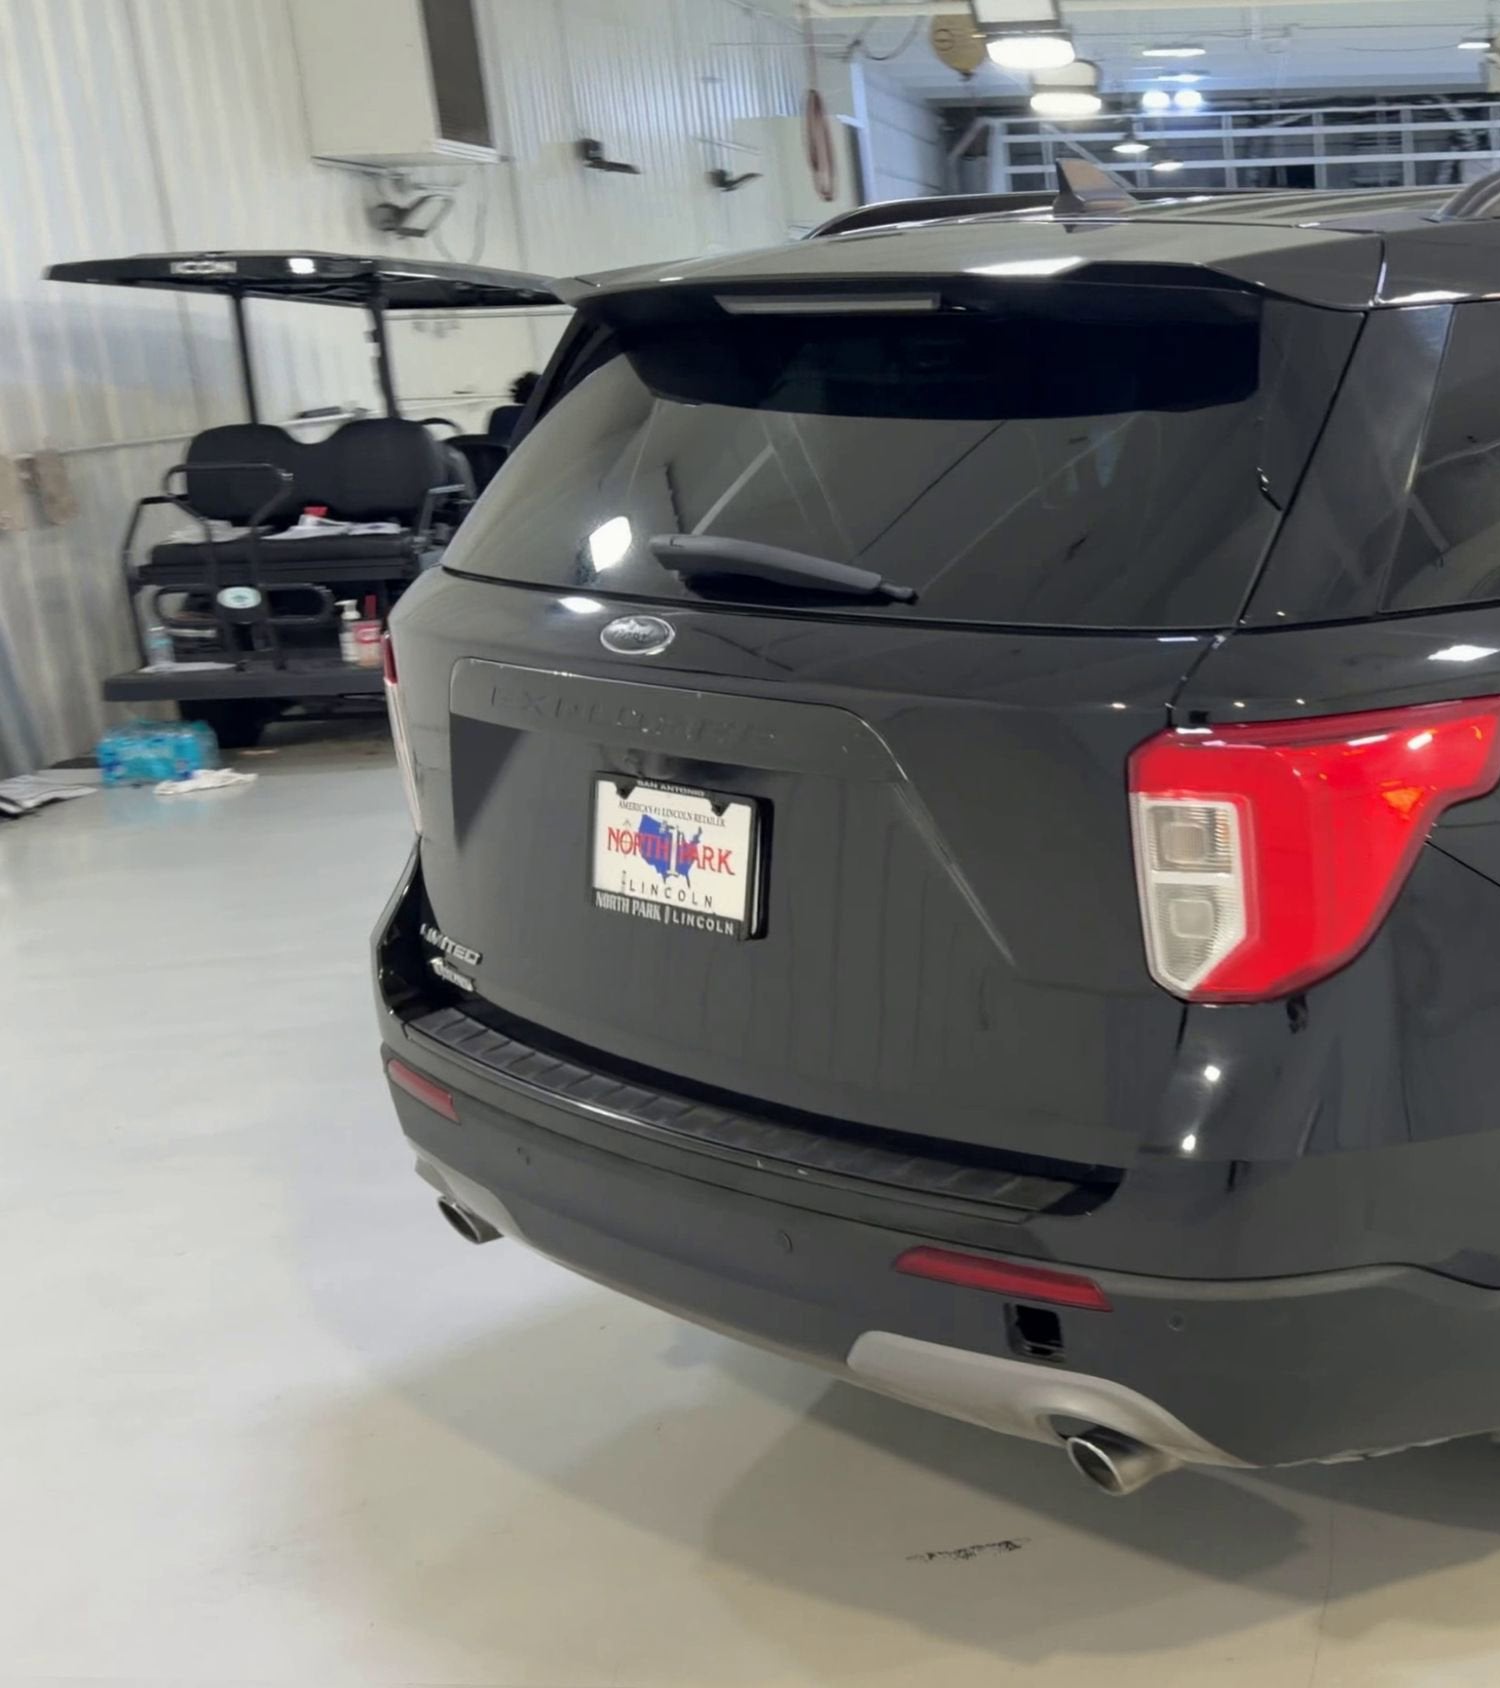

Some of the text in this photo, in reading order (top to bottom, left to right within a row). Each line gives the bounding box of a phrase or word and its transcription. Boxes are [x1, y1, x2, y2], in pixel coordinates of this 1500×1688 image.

[170, 261, 237, 274] ICON
[637, 780, 705, 797] SAN ANTONIO
[661, 807, 692, 823] LINCOLN
[694, 812, 726, 828] RETAILER
[607, 826, 736, 876] NORTH PARK
[628, 879, 713, 908] LINCOLN
[596, 891, 735, 936] NORTH PARK LINCOLN
